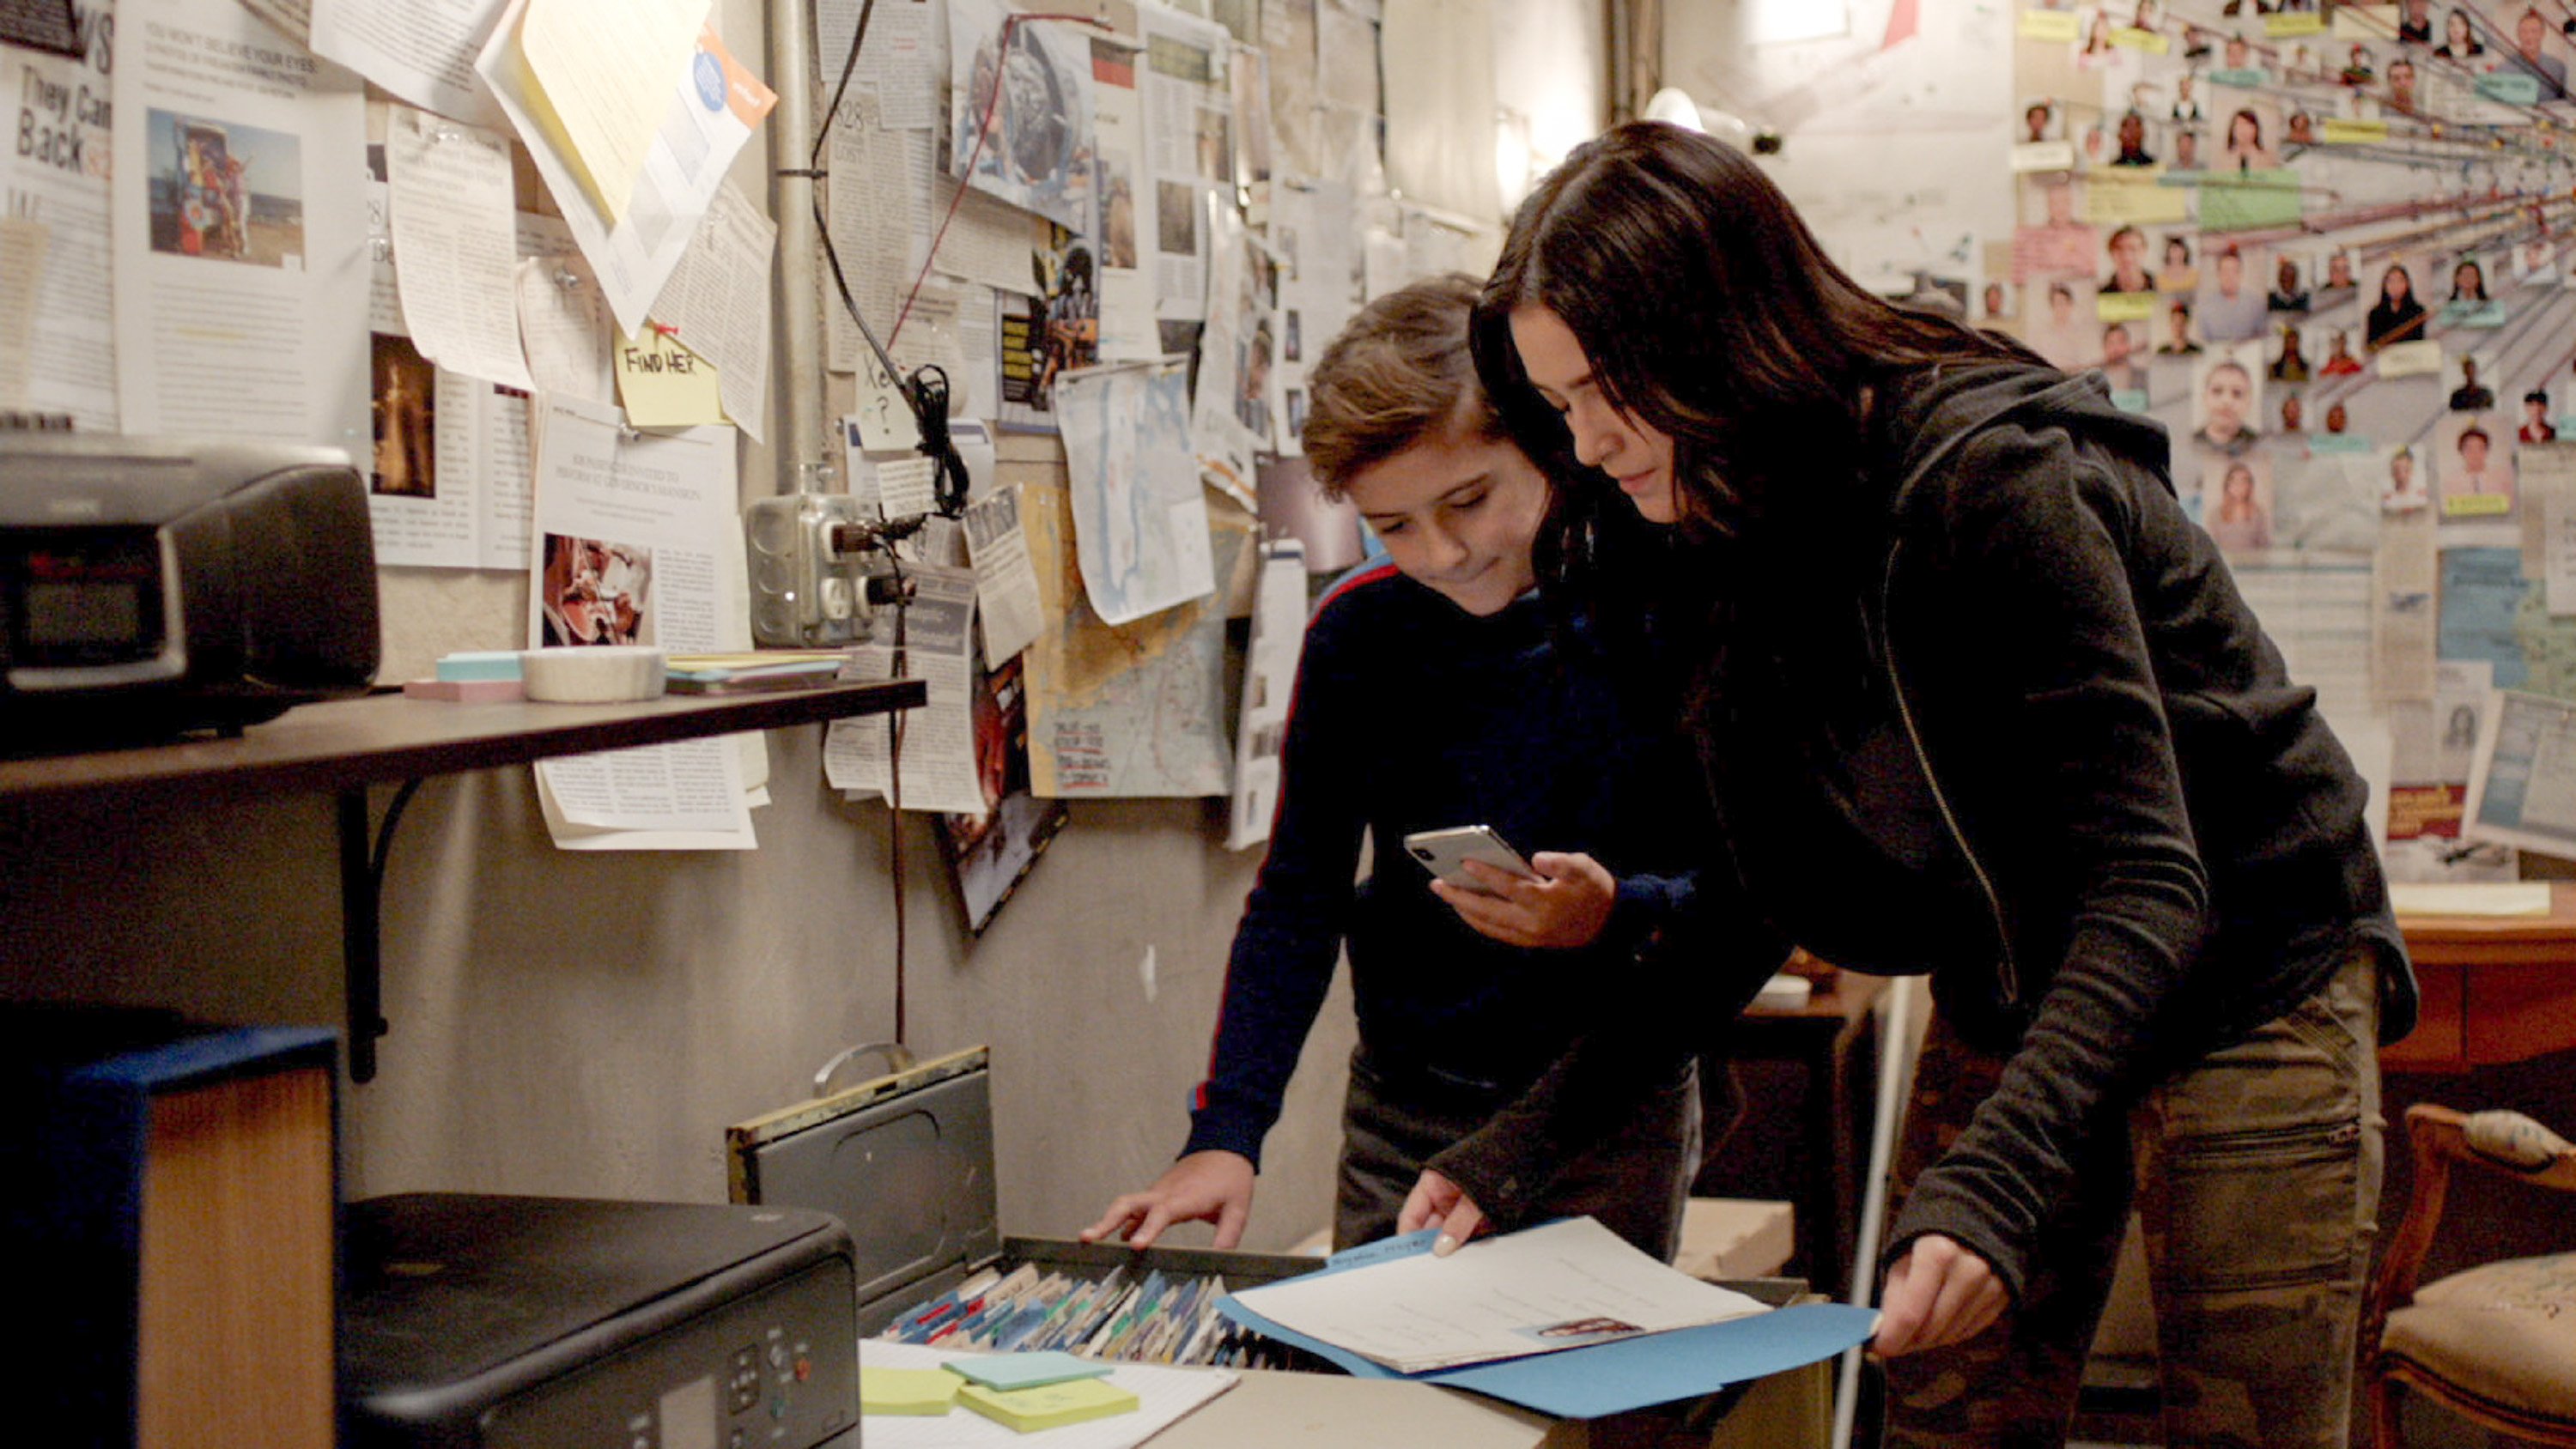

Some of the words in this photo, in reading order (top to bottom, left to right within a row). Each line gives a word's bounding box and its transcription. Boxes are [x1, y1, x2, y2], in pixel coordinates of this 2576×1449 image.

[254, 48, 283, 66] YOUR
[22, 65, 70, 124] They
[17, 107, 82, 173] Back
[624, 347, 663, 373] FIND
[665, 349, 697, 376] HER
